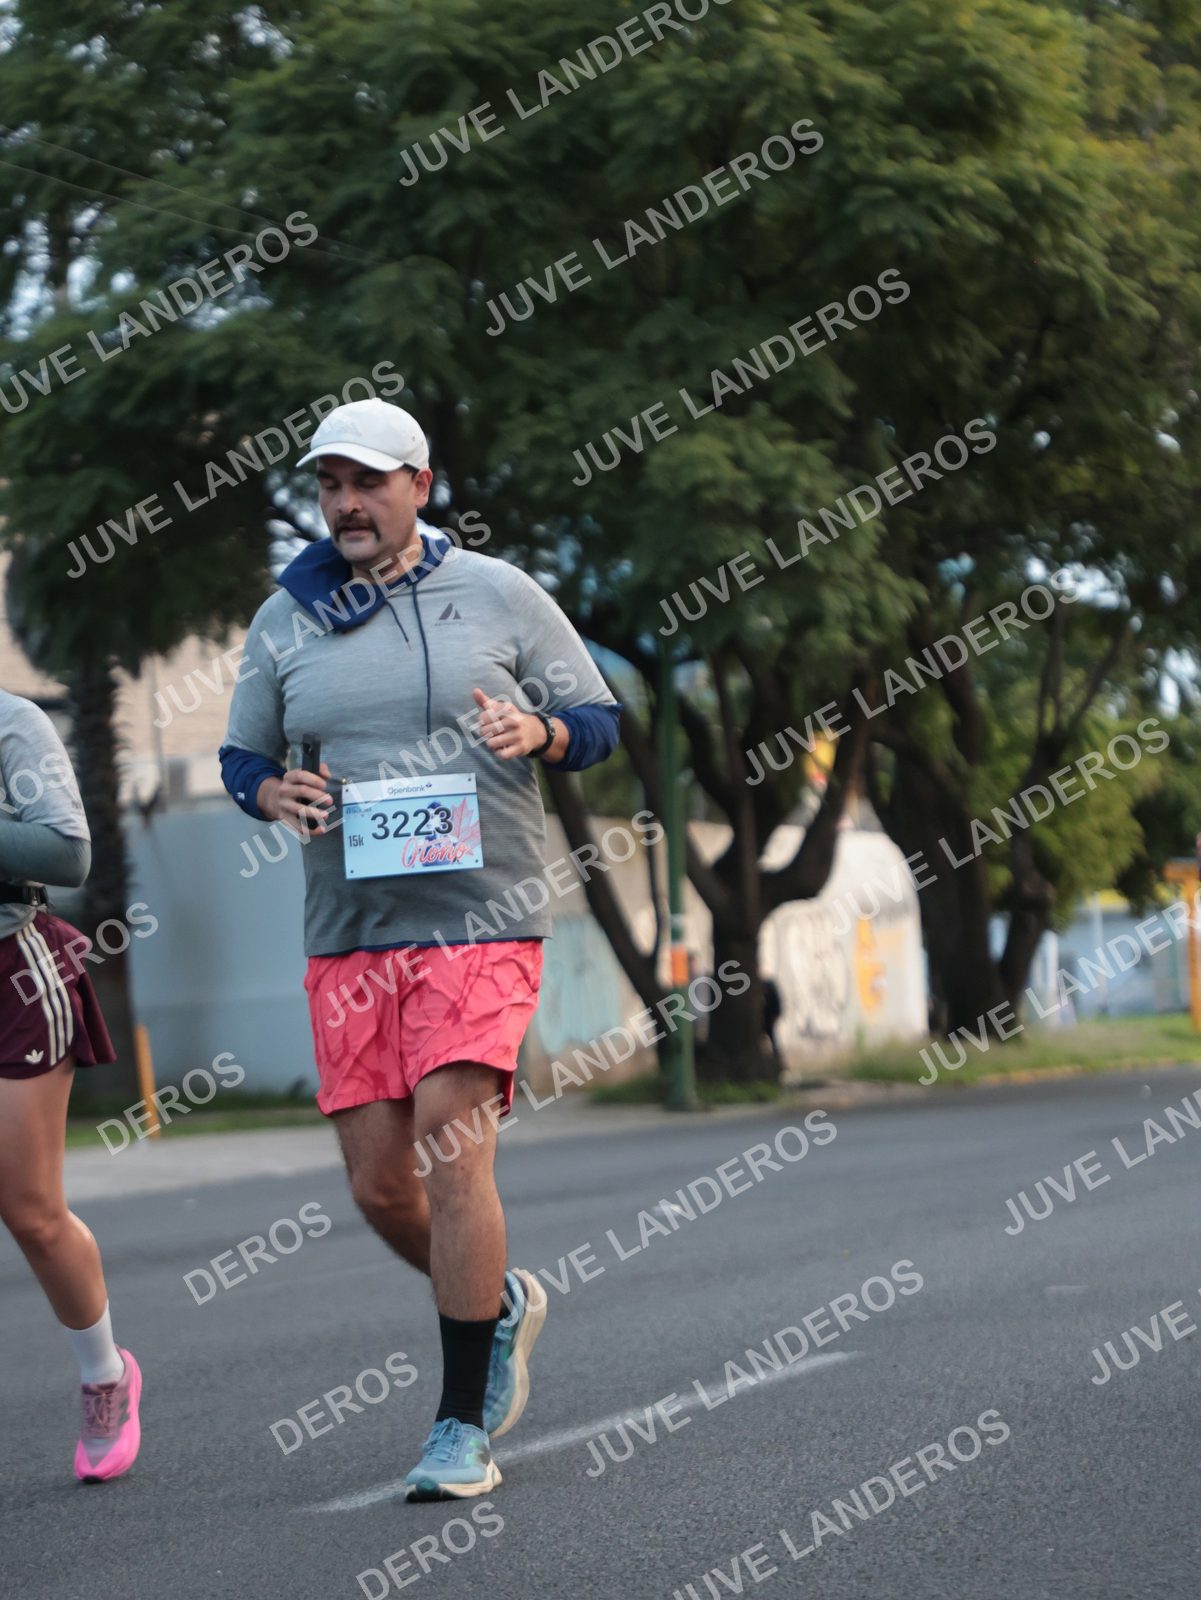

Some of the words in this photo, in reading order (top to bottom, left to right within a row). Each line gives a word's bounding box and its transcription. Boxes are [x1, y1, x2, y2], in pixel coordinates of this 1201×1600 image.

[387, 785, 425, 796] Openbank
[370, 807, 453, 840] 3223
[348, 834, 364, 848] 15k
